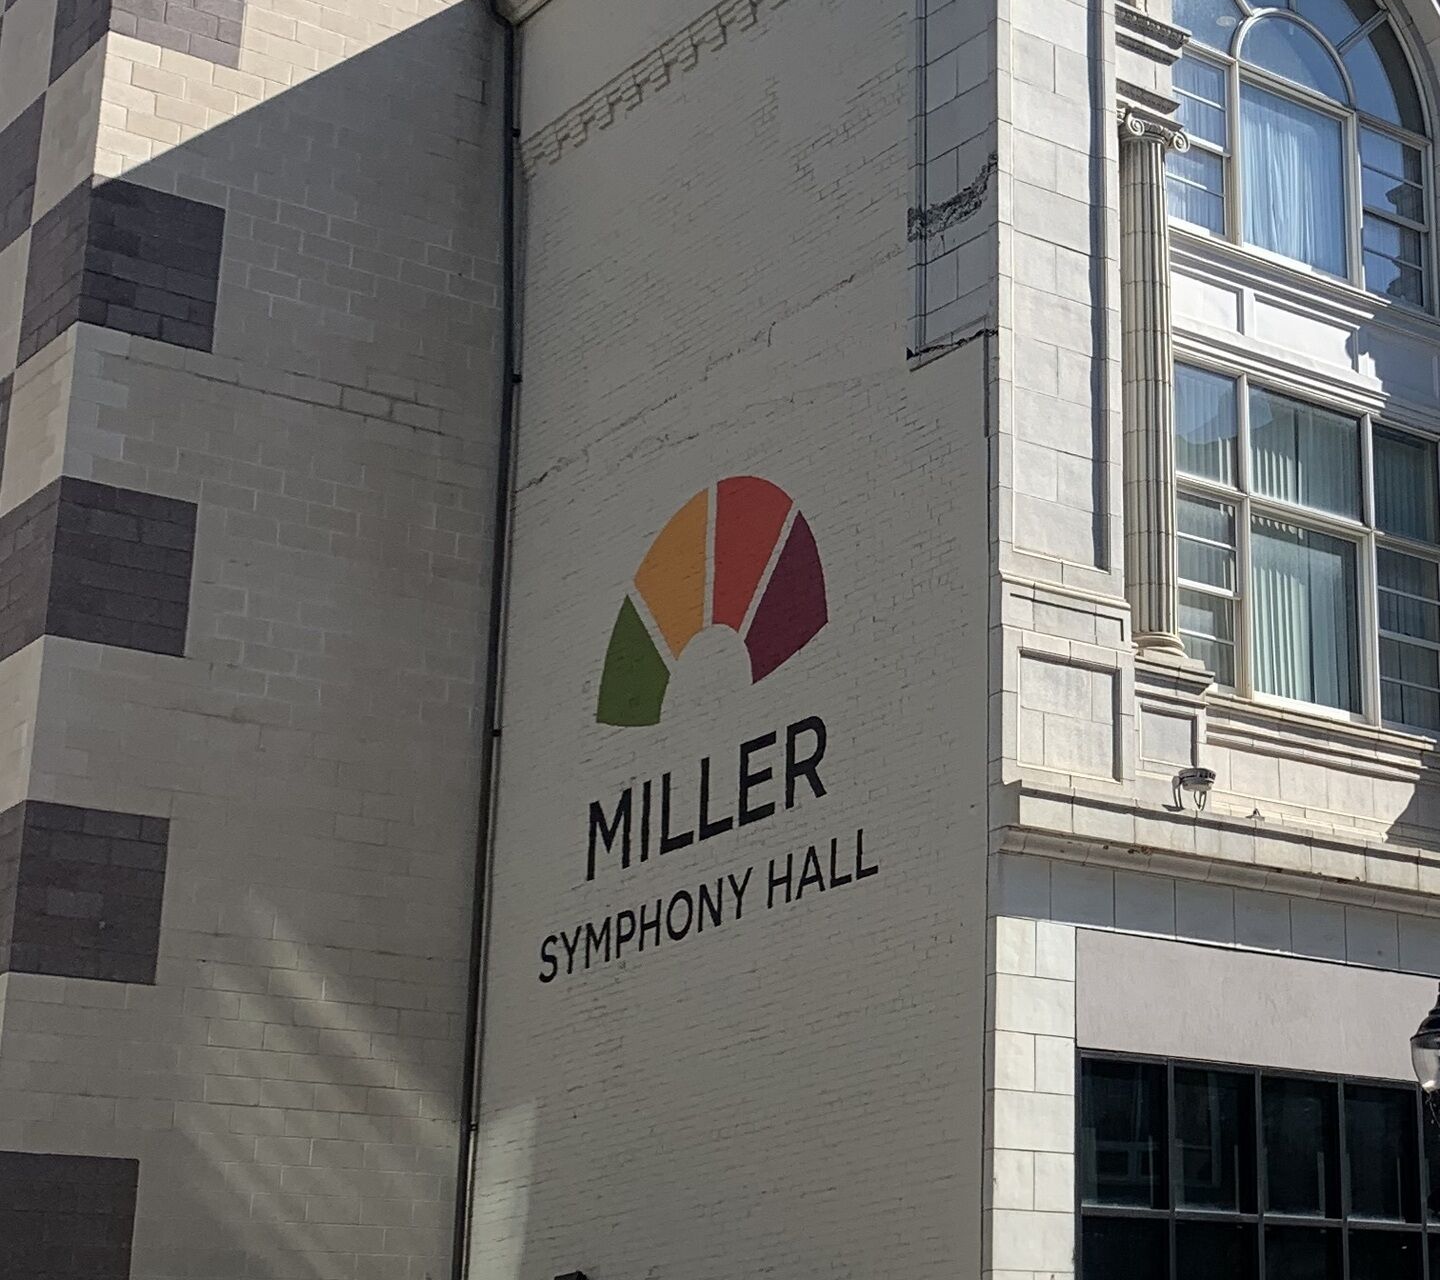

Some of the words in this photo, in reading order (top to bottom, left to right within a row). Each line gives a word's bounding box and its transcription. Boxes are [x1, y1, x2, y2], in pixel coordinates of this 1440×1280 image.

[586, 716, 828, 881] MILLER
[538, 867, 753, 983] SYMPHONY
[767, 829, 879, 909] HALL
